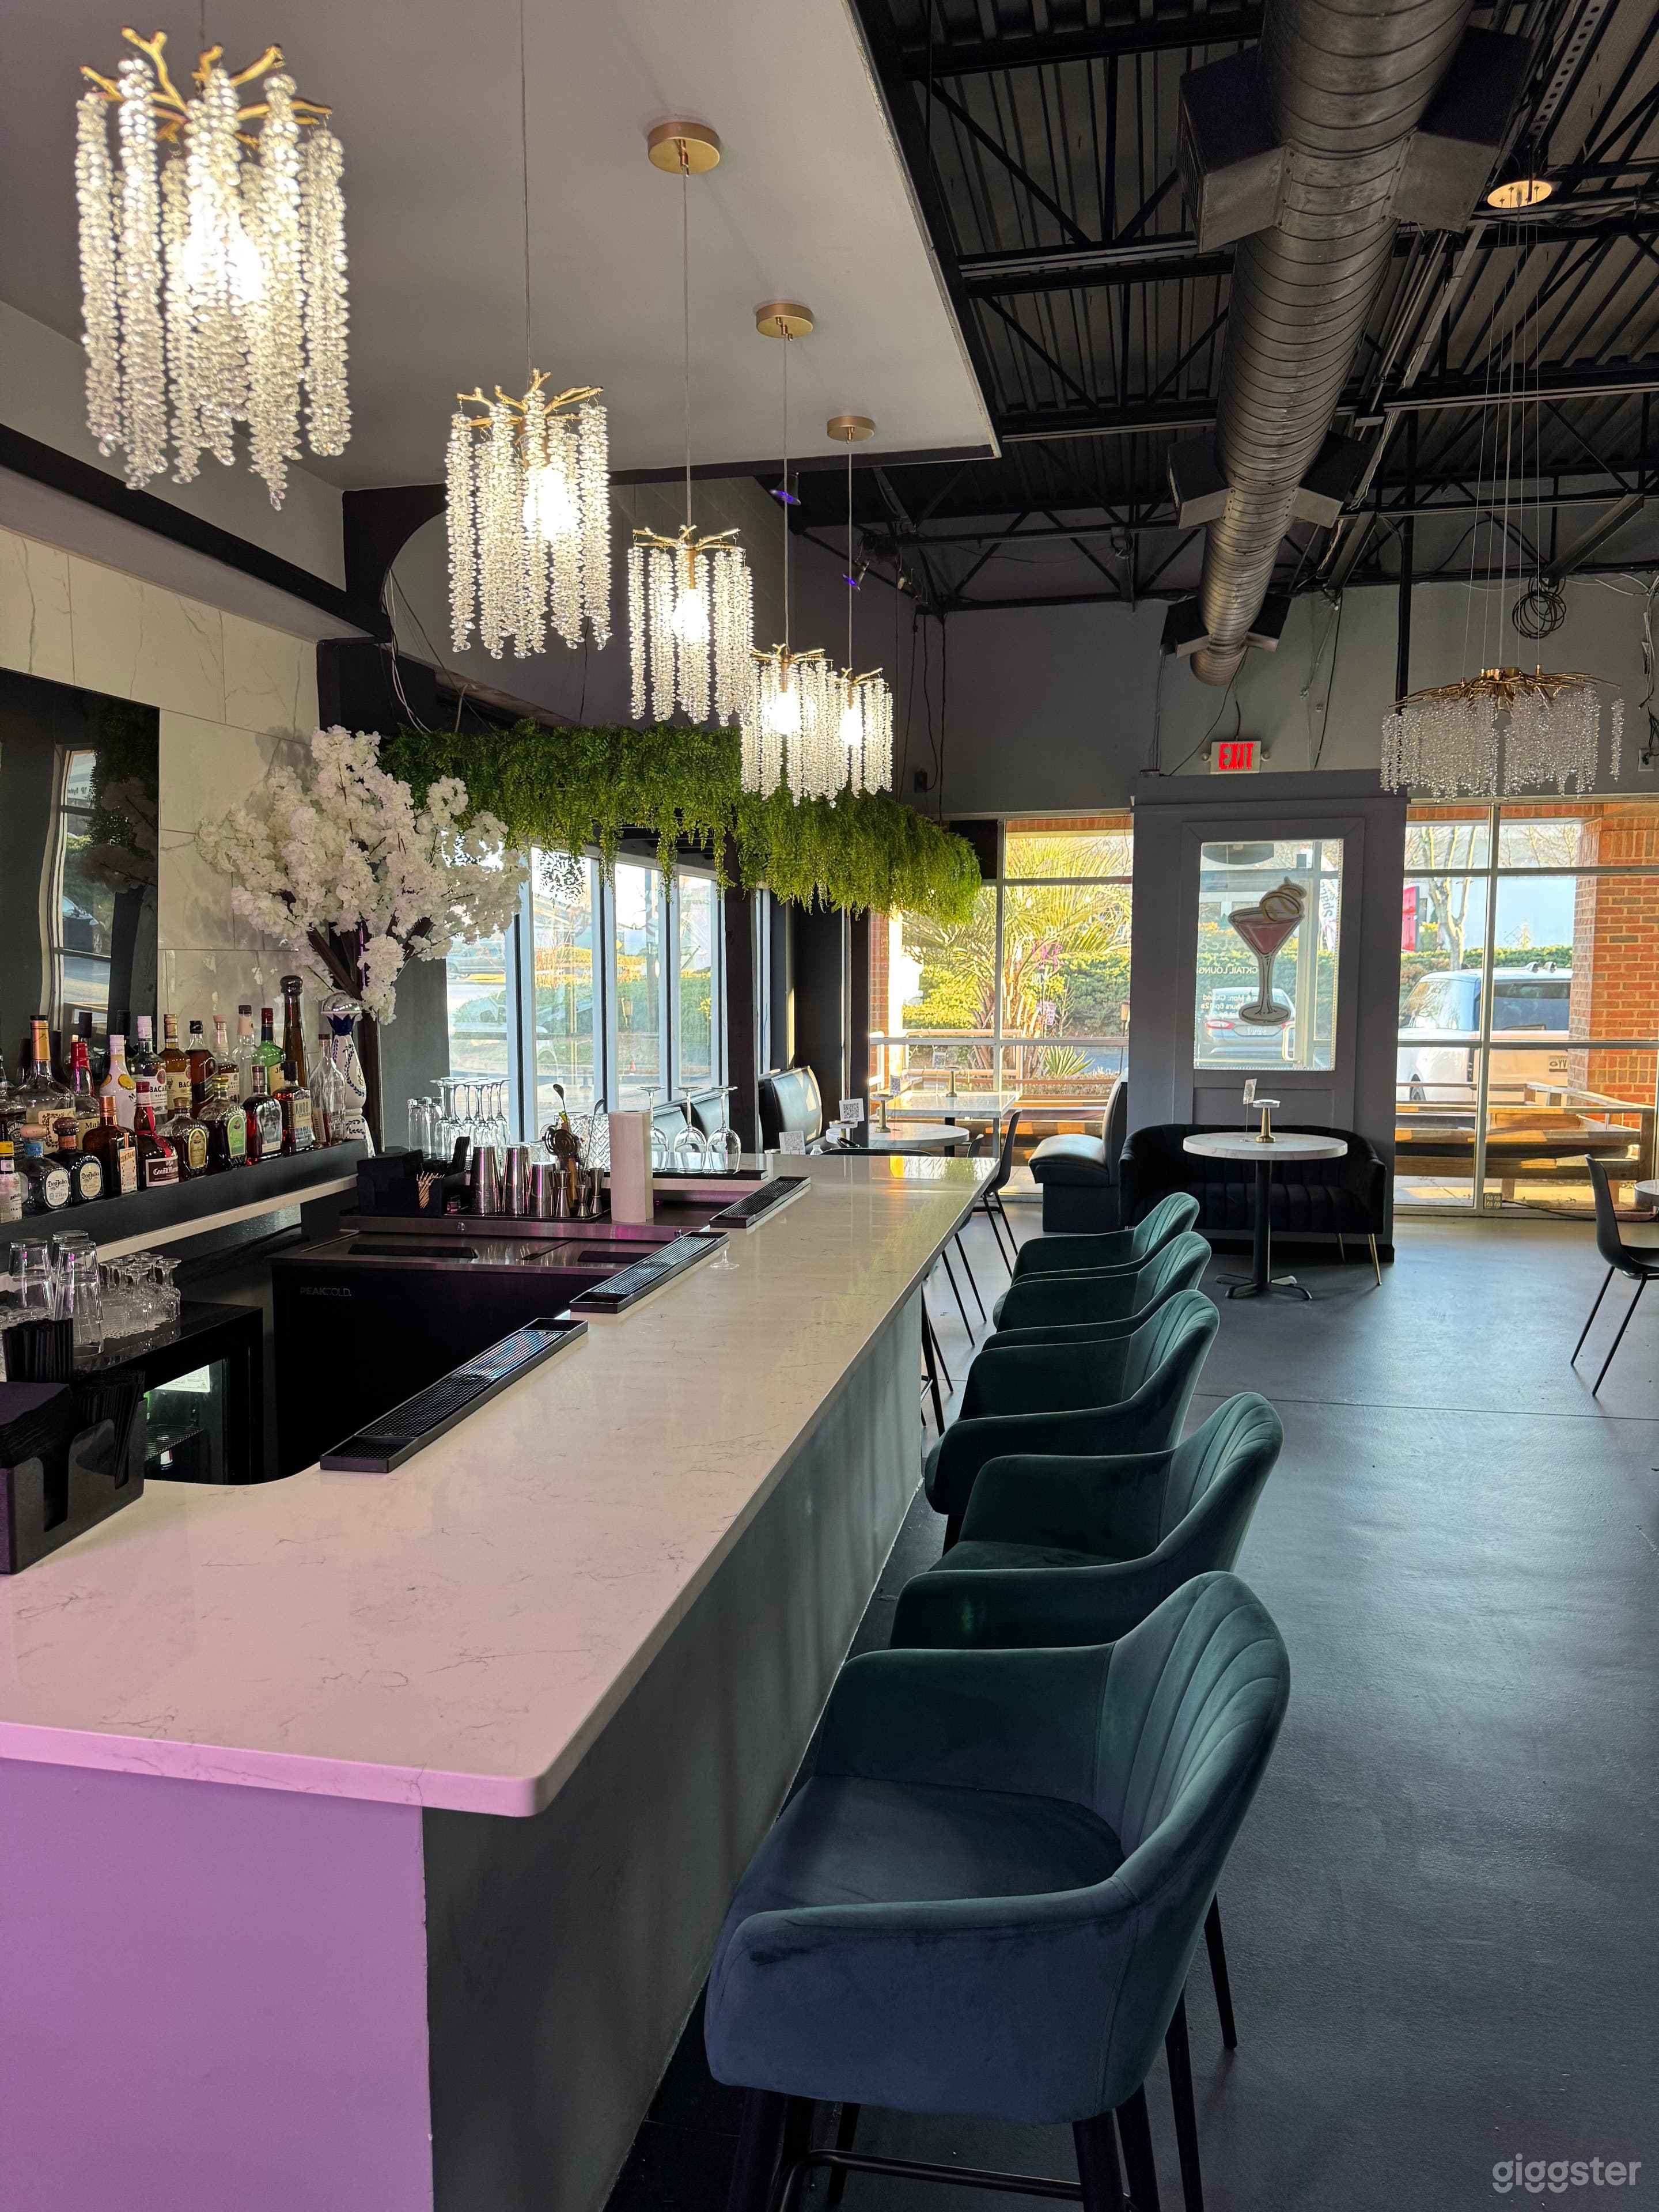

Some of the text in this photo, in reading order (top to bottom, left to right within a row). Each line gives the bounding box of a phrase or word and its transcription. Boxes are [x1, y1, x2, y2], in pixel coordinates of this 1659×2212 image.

[1219, 743, 1255, 770] EXIT
[88, 1172, 99, 1180] Julio
[56, 1179, 67, 1188] Julio
